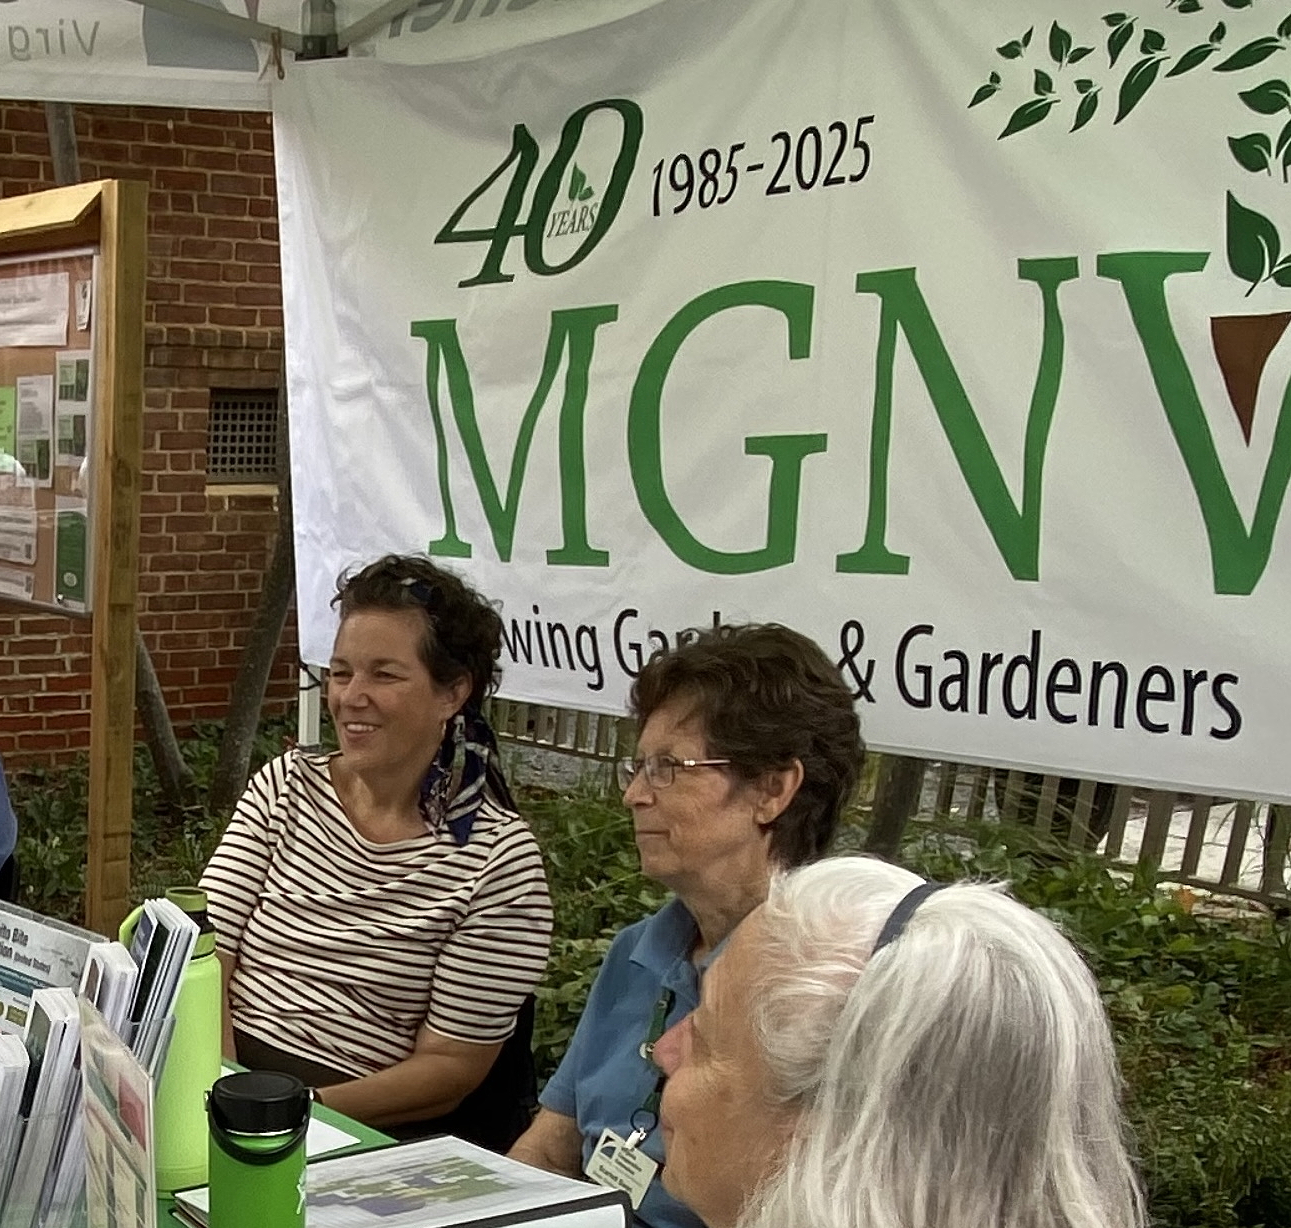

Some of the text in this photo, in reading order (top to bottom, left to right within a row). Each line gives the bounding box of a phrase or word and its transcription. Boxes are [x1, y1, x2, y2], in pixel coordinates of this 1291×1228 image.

[433, 98, 644, 288] 40
[546, 202, 601, 239] YEARS
[651, 114, 877, 218] 1985-2025
[502, 604, 605, 691] wing
[837, 619, 877, 705] &
[894, 623, 1243, 741] Gardeners
